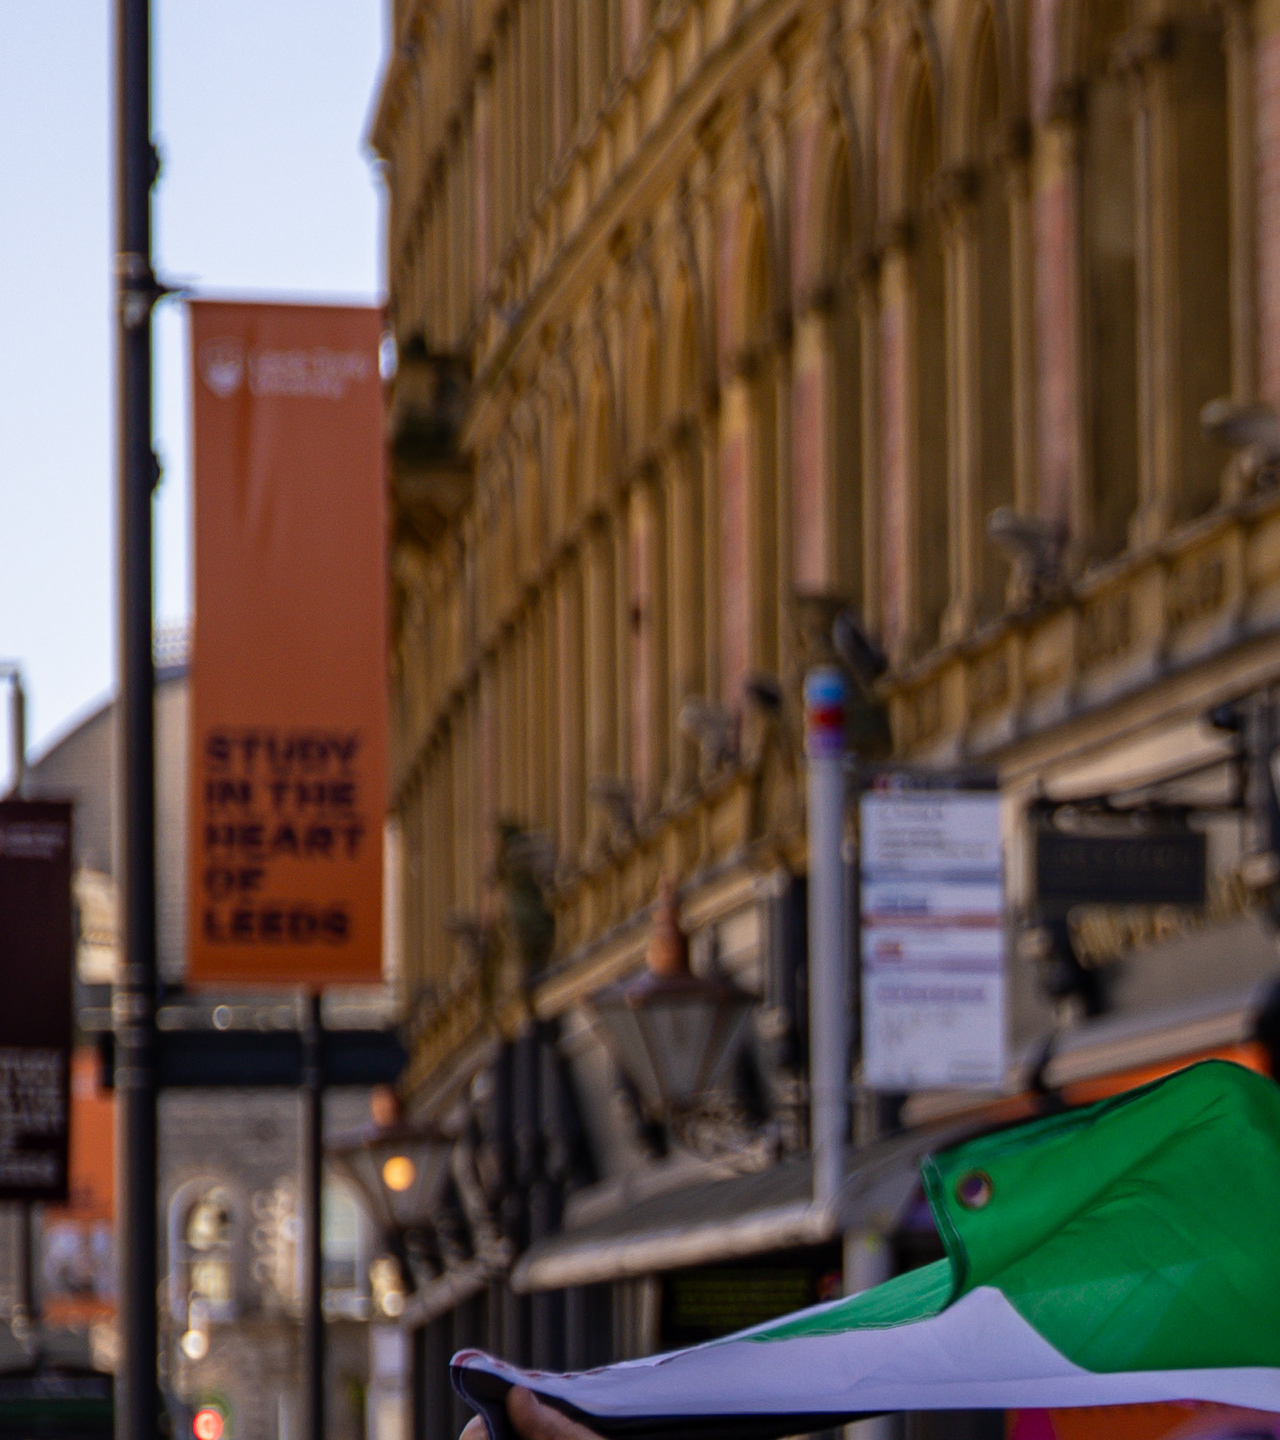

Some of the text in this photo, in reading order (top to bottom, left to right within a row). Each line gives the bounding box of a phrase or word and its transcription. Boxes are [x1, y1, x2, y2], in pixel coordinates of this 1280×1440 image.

[207, 733, 358, 769] STUDY
[206, 780, 355, 807] IN THE
[206, 823, 363, 853] HEART
[206, 866, 264, 894] OF
[205, 909, 349, 943] LEEDS
